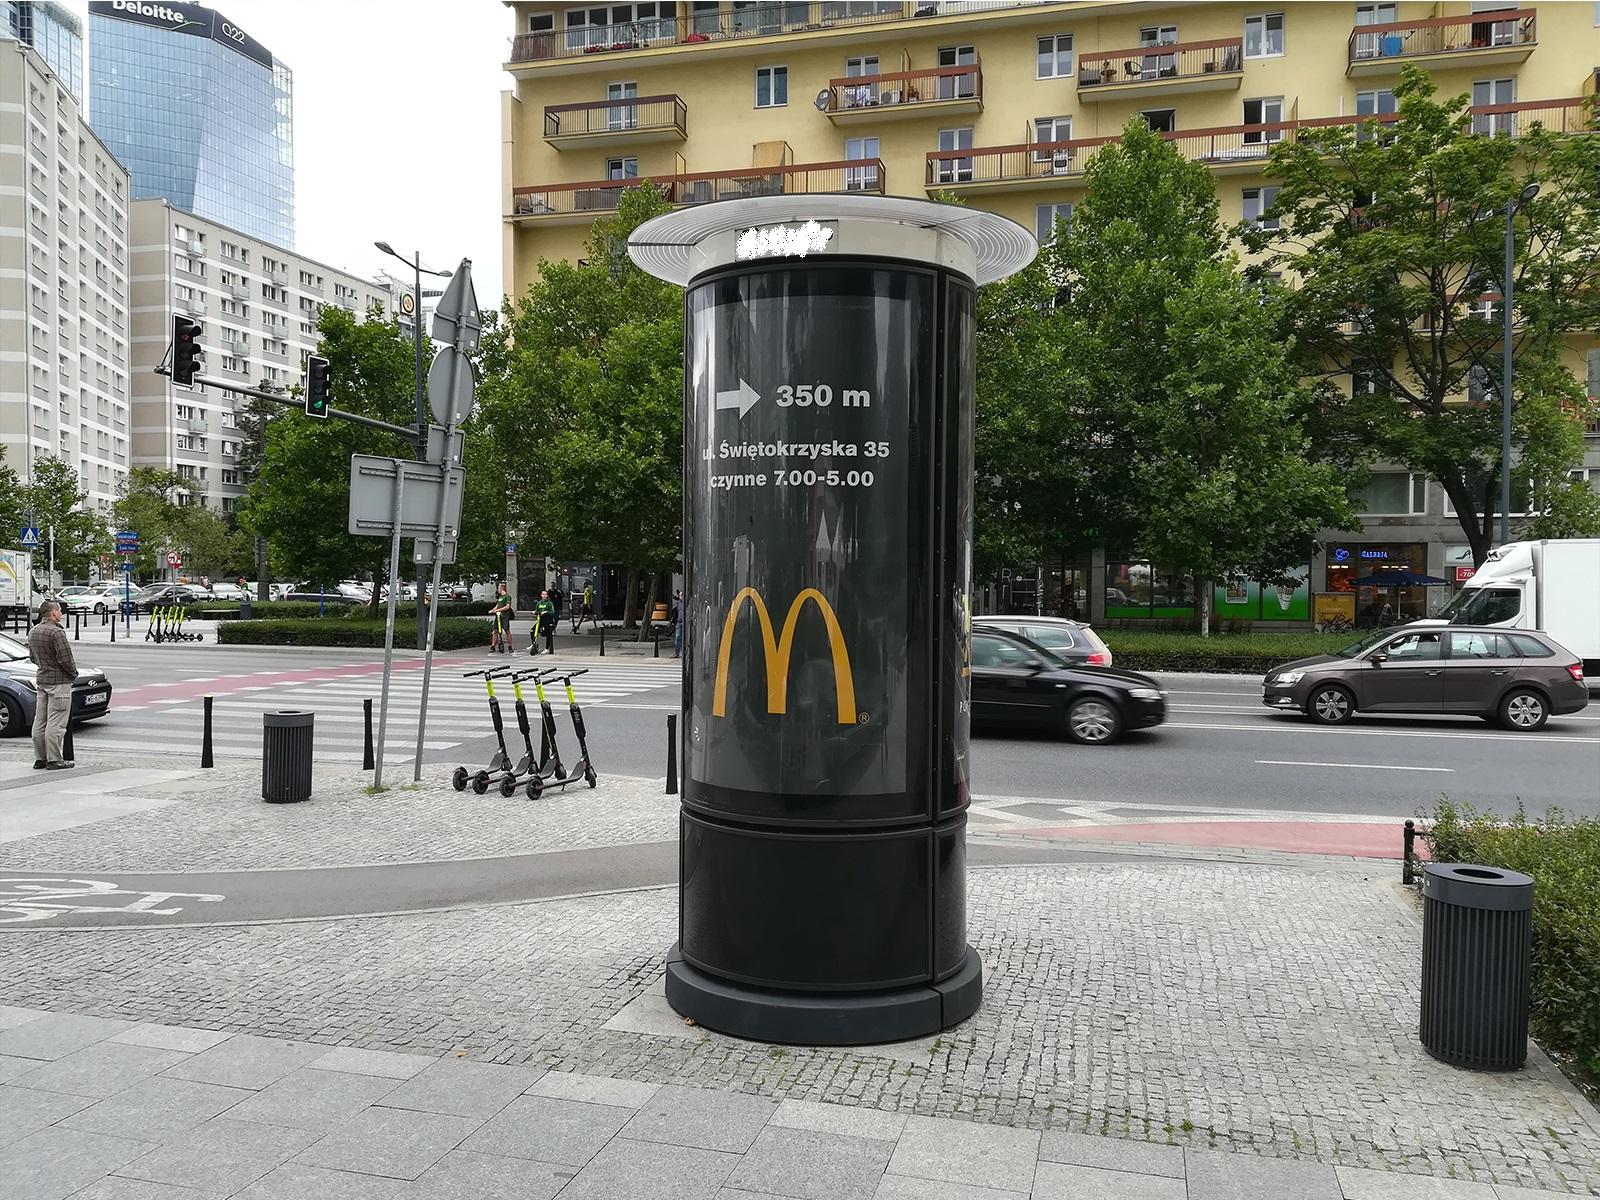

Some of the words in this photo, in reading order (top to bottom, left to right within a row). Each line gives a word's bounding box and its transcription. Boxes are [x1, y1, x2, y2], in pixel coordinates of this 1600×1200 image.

[221, 23, 245, 44] Q22
[776, 384, 833, 407] 350
[842, 390, 870, 407] m
[719, 440, 858, 460] Świętokrzyska
[863, 441, 890, 457] 35
[710, 474, 767, 490] czynne
[773, 470, 874, 486] 7.00-5.00
